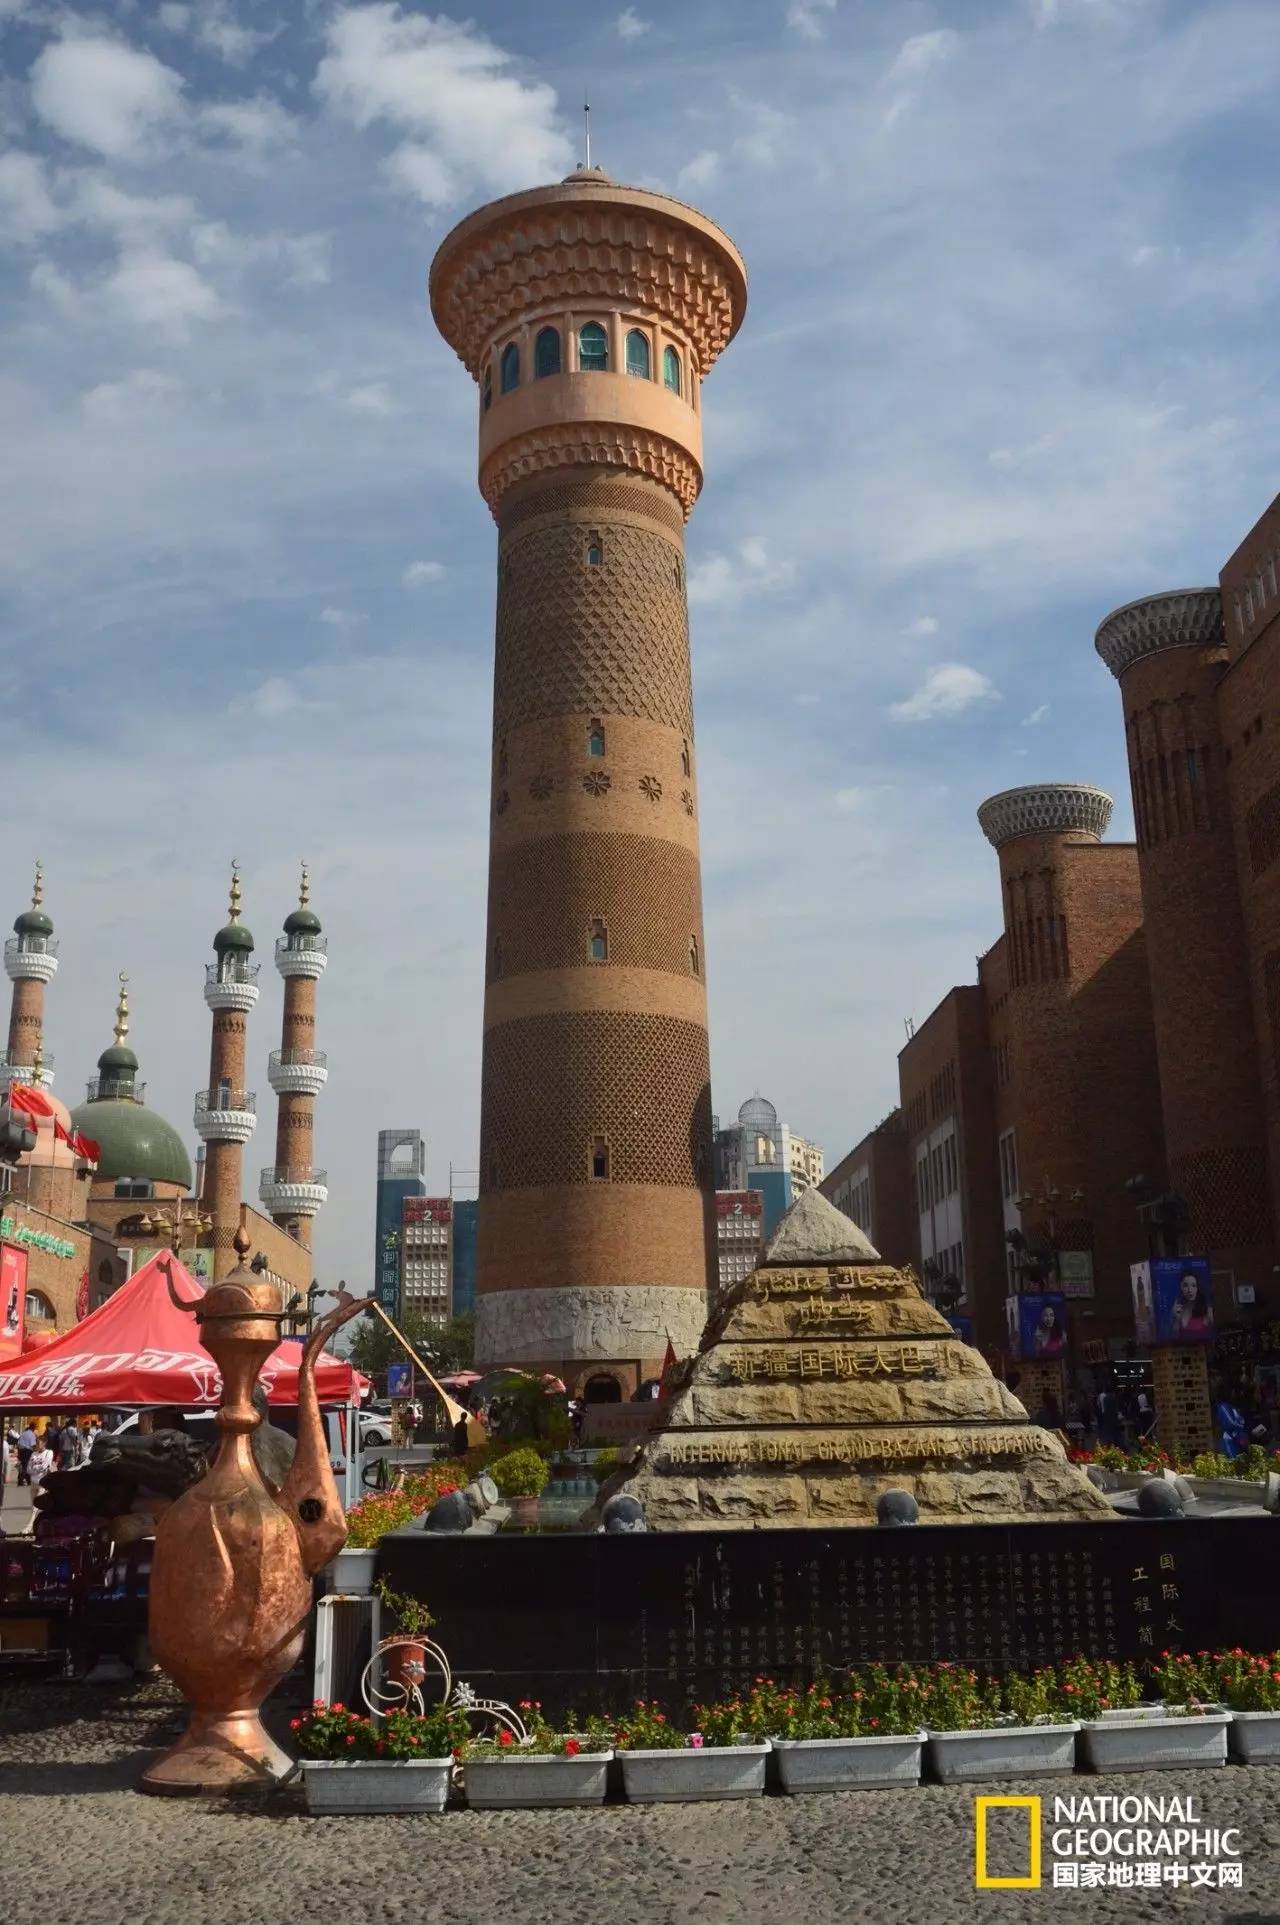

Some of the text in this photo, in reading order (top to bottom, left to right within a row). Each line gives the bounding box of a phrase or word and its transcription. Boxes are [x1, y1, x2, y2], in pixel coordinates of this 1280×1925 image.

[669, 1439, 812, 1463] INTERNATIONAL
[818, 1438, 875, 1461] GRAND
[879, 1437, 947, 1459] BAZAAR
